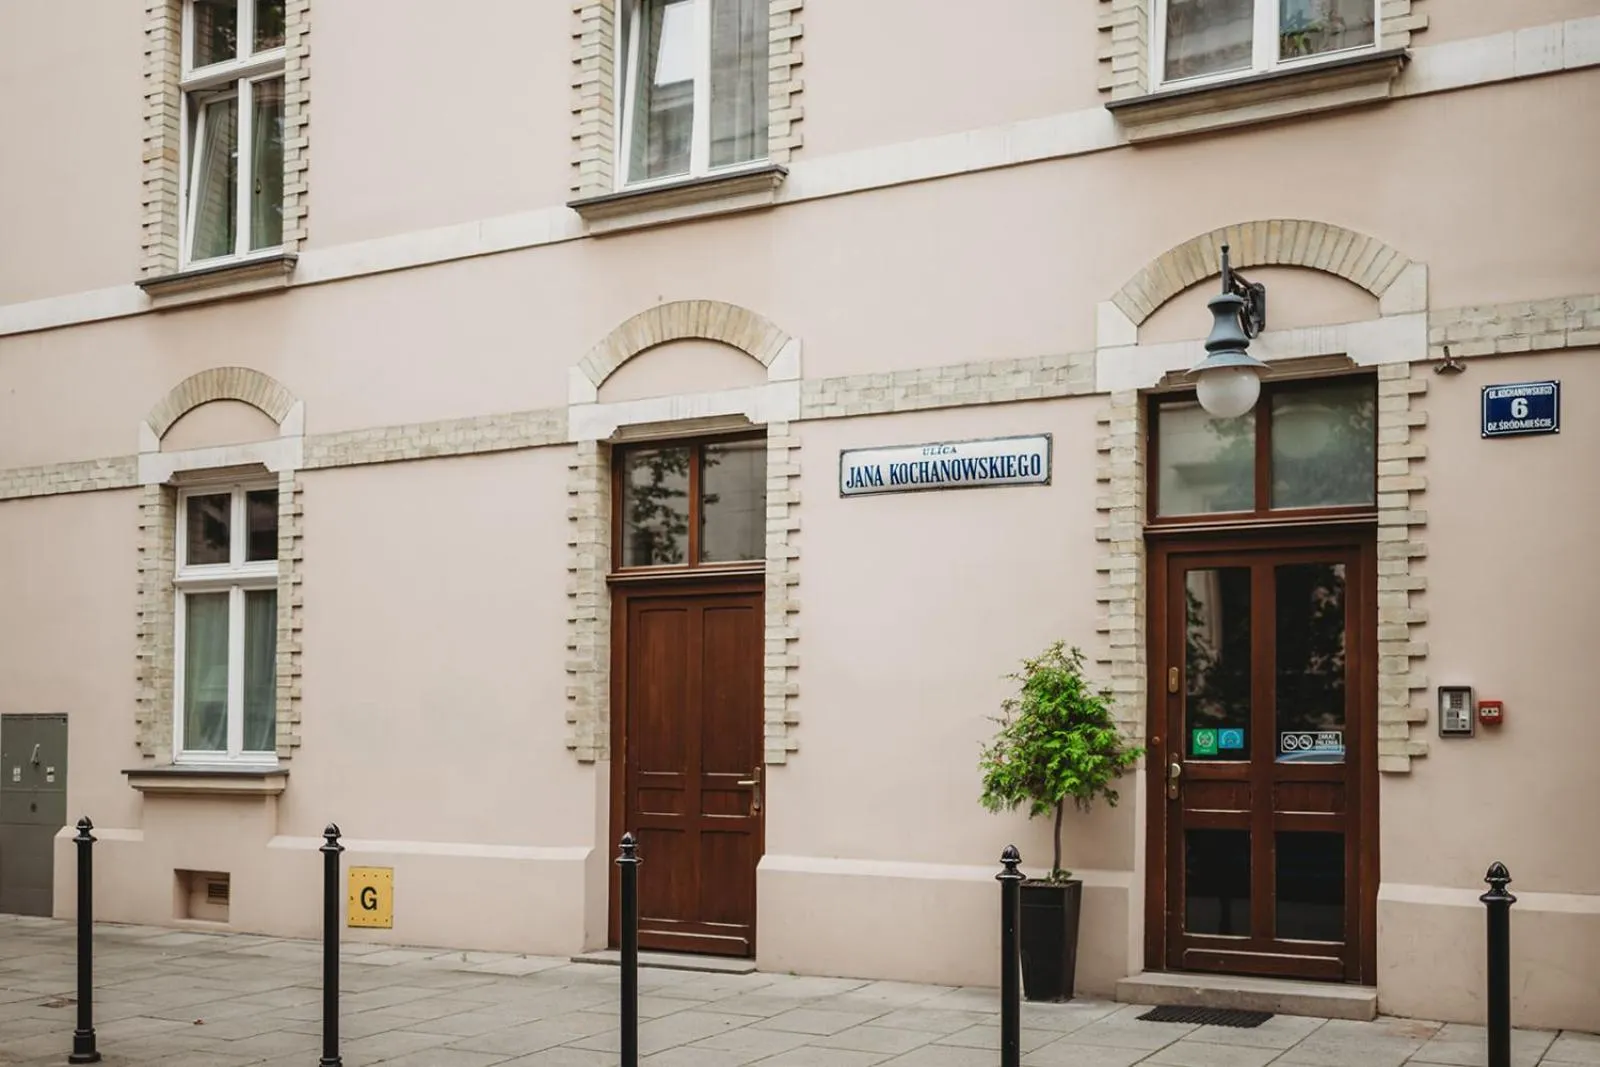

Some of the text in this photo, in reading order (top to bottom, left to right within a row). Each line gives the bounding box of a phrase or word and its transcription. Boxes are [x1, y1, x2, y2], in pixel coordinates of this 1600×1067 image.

[1511, 398, 1528, 418] 6
[1500, 418, 1552, 430] ŚRÓDMIEŚCIE
[922, 445, 957, 456] ULICA
[846, 453, 1041, 488] JANA KOCHANOWSKIEGO
[361, 887, 377, 911] G
